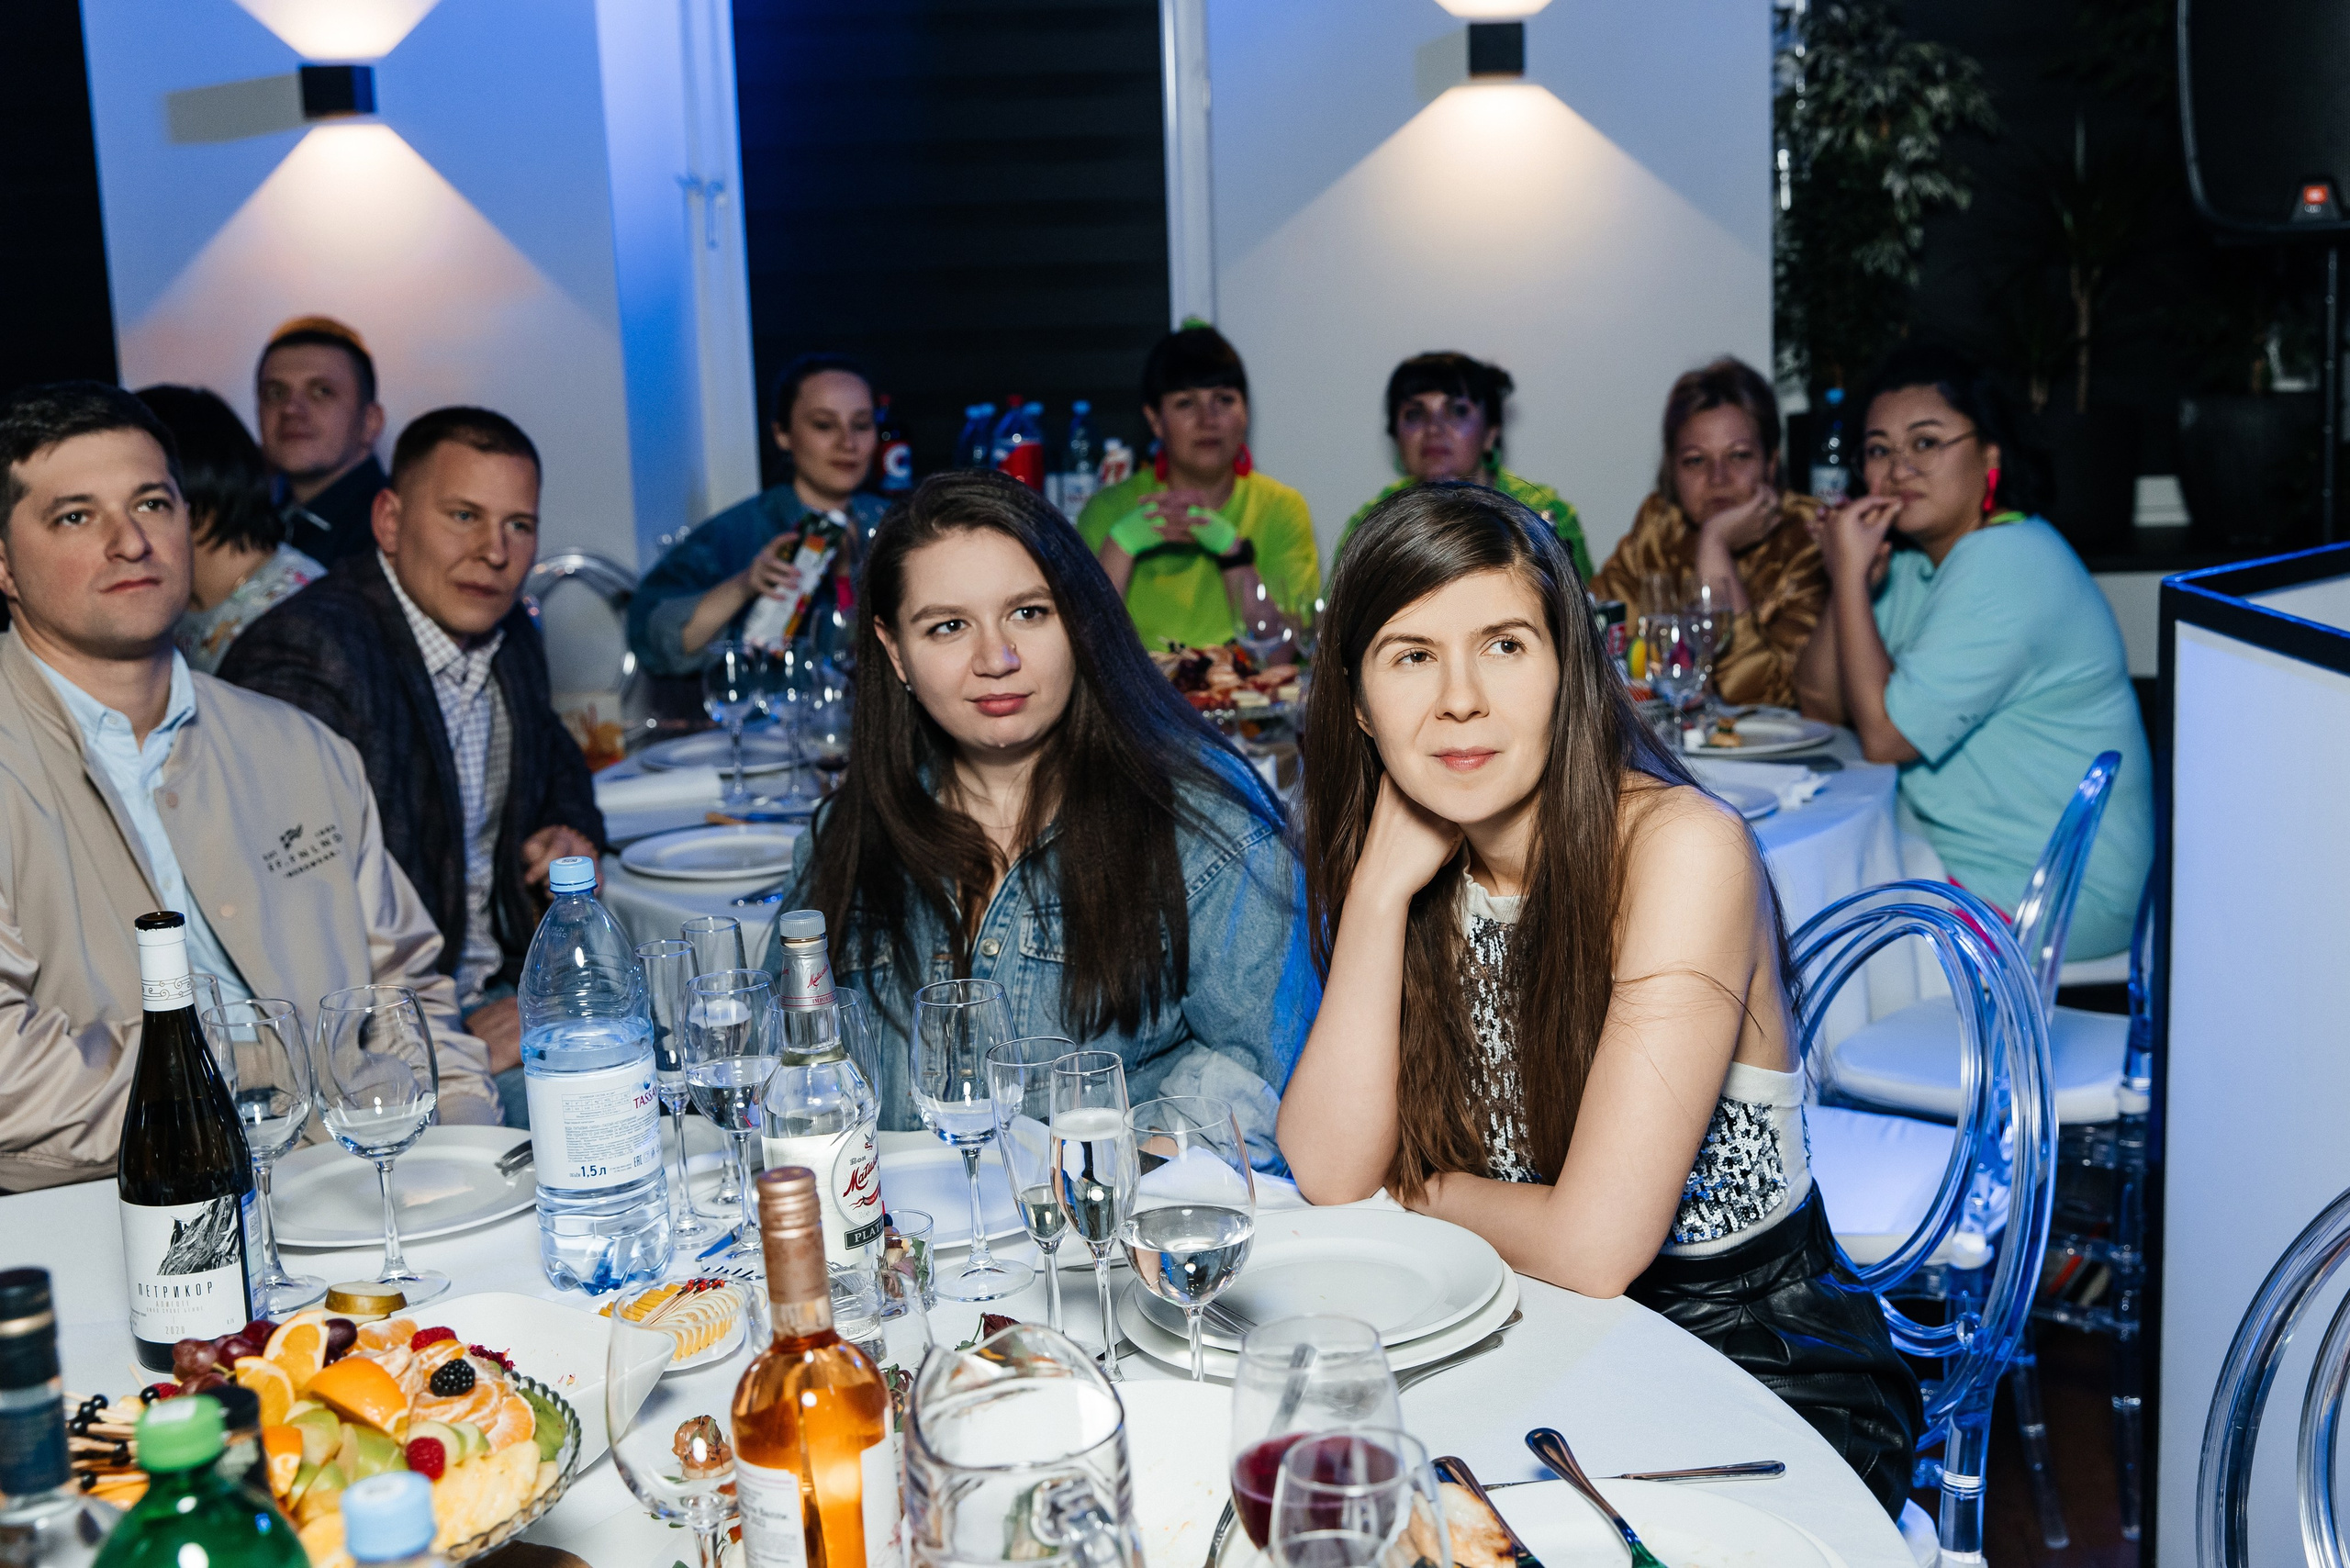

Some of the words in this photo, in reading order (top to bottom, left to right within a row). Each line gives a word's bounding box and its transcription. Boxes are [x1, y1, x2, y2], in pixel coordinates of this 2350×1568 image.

[849, 1155, 867, 1166] Ron
[580, 1165, 598, 1178] 1,5
[599, 1167, 607, 1176] л
[138, 1281, 213, 1299] ПЕТРИКОР
[165, 1326, 185, 1335] 2020
